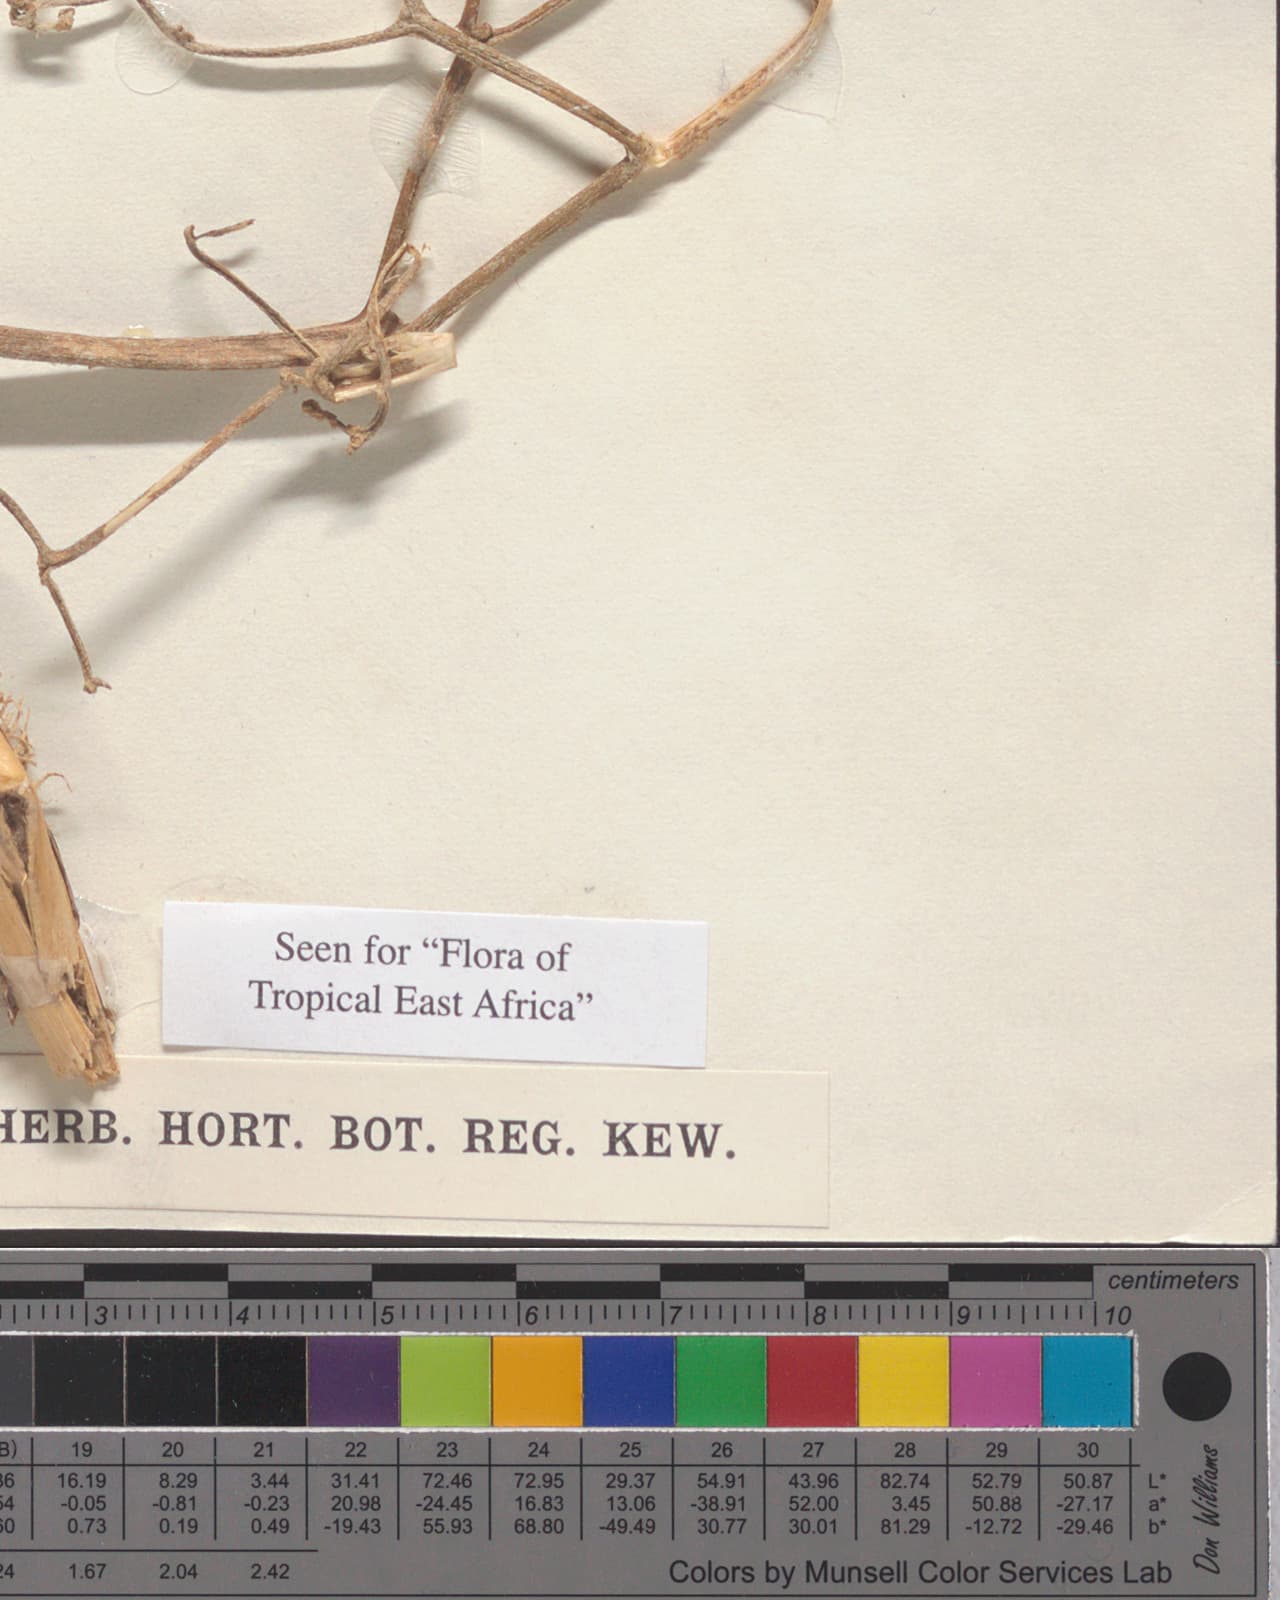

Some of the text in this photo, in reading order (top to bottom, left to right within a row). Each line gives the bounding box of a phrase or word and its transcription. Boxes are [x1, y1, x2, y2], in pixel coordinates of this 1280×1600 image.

[276, 932, 572, 971] Seen for “Flora of
[249, 980, 592, 1021] Tropical East Africa”
[159, 1111, 302, 1149] HORT.
[330, 1115, 435, 1152] BOT.
[463, 1119, 574, 1156] REG.
[603, 1121, 735, 1159] KEW.
[1109, 1270, 1239, 1289] centimeters
[93, 1306, 108, 1325] 3
[235, 1306, 250, 1325] 4
[380, 1306, 394, 1326] 5
[525, 1306, 539, 1325] 6
[669, 1306, 683, 1326] 7
[813, 1306, 826, 1326] 8
[957, 1306, 971, 1326] 9
[1104, 1306, 1132, 1326] 10
[58, 1473, 106, 1488] 16.19
[160, 1473, 197, 1488] 8.29
[251, 1473, 289, 1488] 3.44
[332, 1473, 378, 1488] 31.41
[423, 1473, 472, 1488] 72.46
[515, 1473, 564, 1488] 72.95
[606, 1473, 655, 1488] 29.37
[698, 1473, 744, 1488] 54.91
[789, 1473, 839, 1488] 43.96
[881, 1473, 930, 1489] 82.74
[973, 1473, 1021, 1488] 52.79
[1064, 1473, 1112, 1489] 50.87
[1192, 1444, 1220, 1576] Don Williams
[670, 1560, 1172, 1589] Colors by Munsell Color Services Lab
